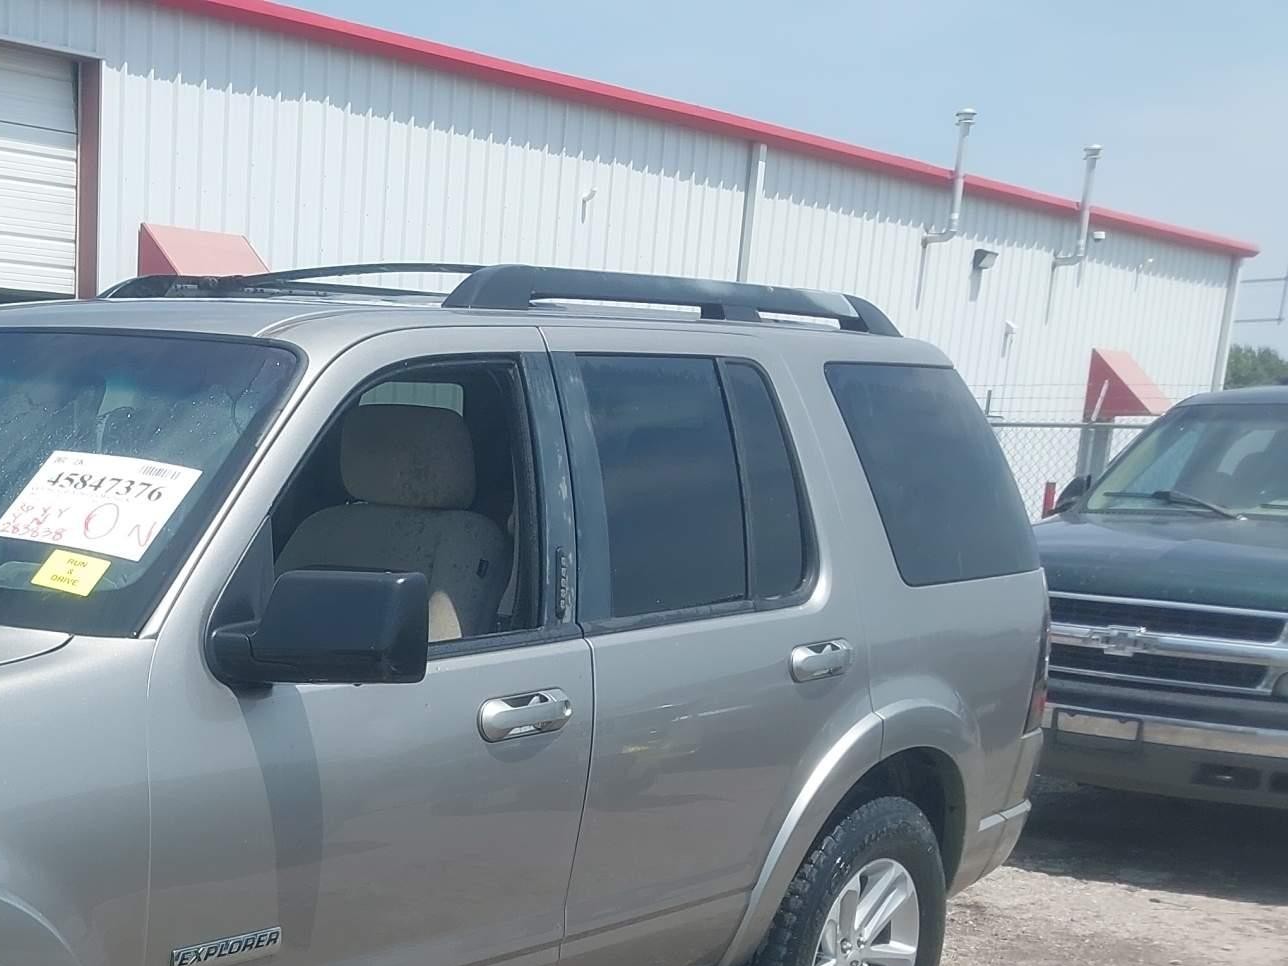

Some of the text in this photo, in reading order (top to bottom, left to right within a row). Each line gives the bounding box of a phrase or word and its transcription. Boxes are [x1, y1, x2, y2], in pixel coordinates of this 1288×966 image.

[47, 471, 167, 502] 45847376
[66, 557, 89, 568] RUN
[50, 574, 80, 586] DRIVE
[177, 930, 280, 966] EXPLORER
